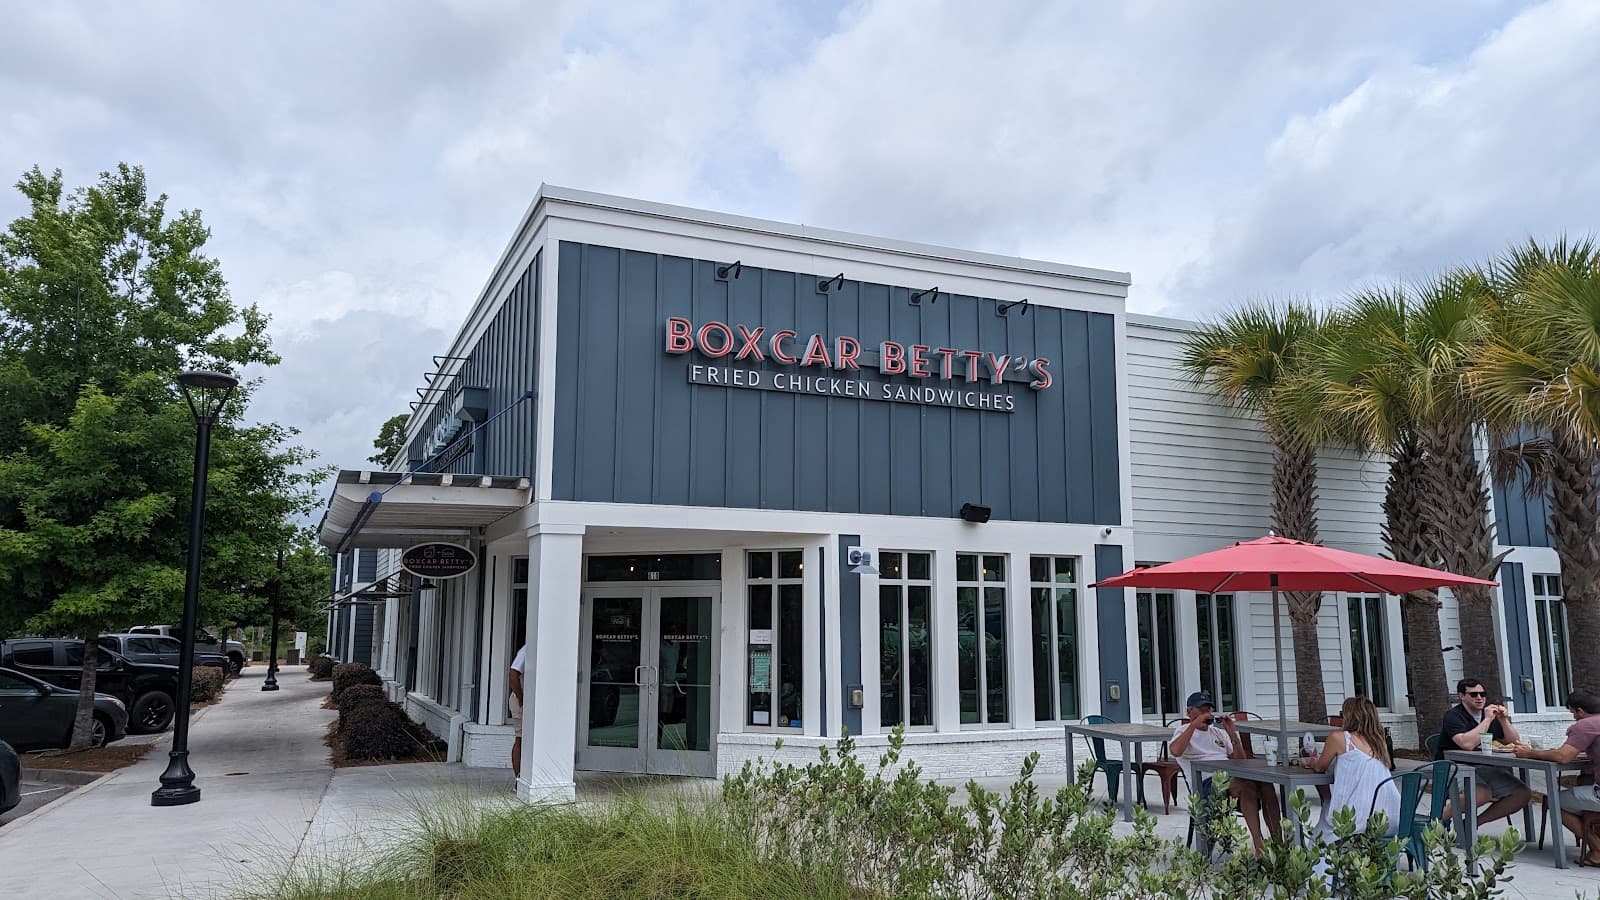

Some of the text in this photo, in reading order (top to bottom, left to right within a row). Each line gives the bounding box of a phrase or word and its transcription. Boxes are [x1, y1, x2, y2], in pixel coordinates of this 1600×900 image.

[666, 317, 1052, 390] BOXCAR BETTY'S
[692, 365, 1014, 410] FRIED CHICKEN SANDWICHES
